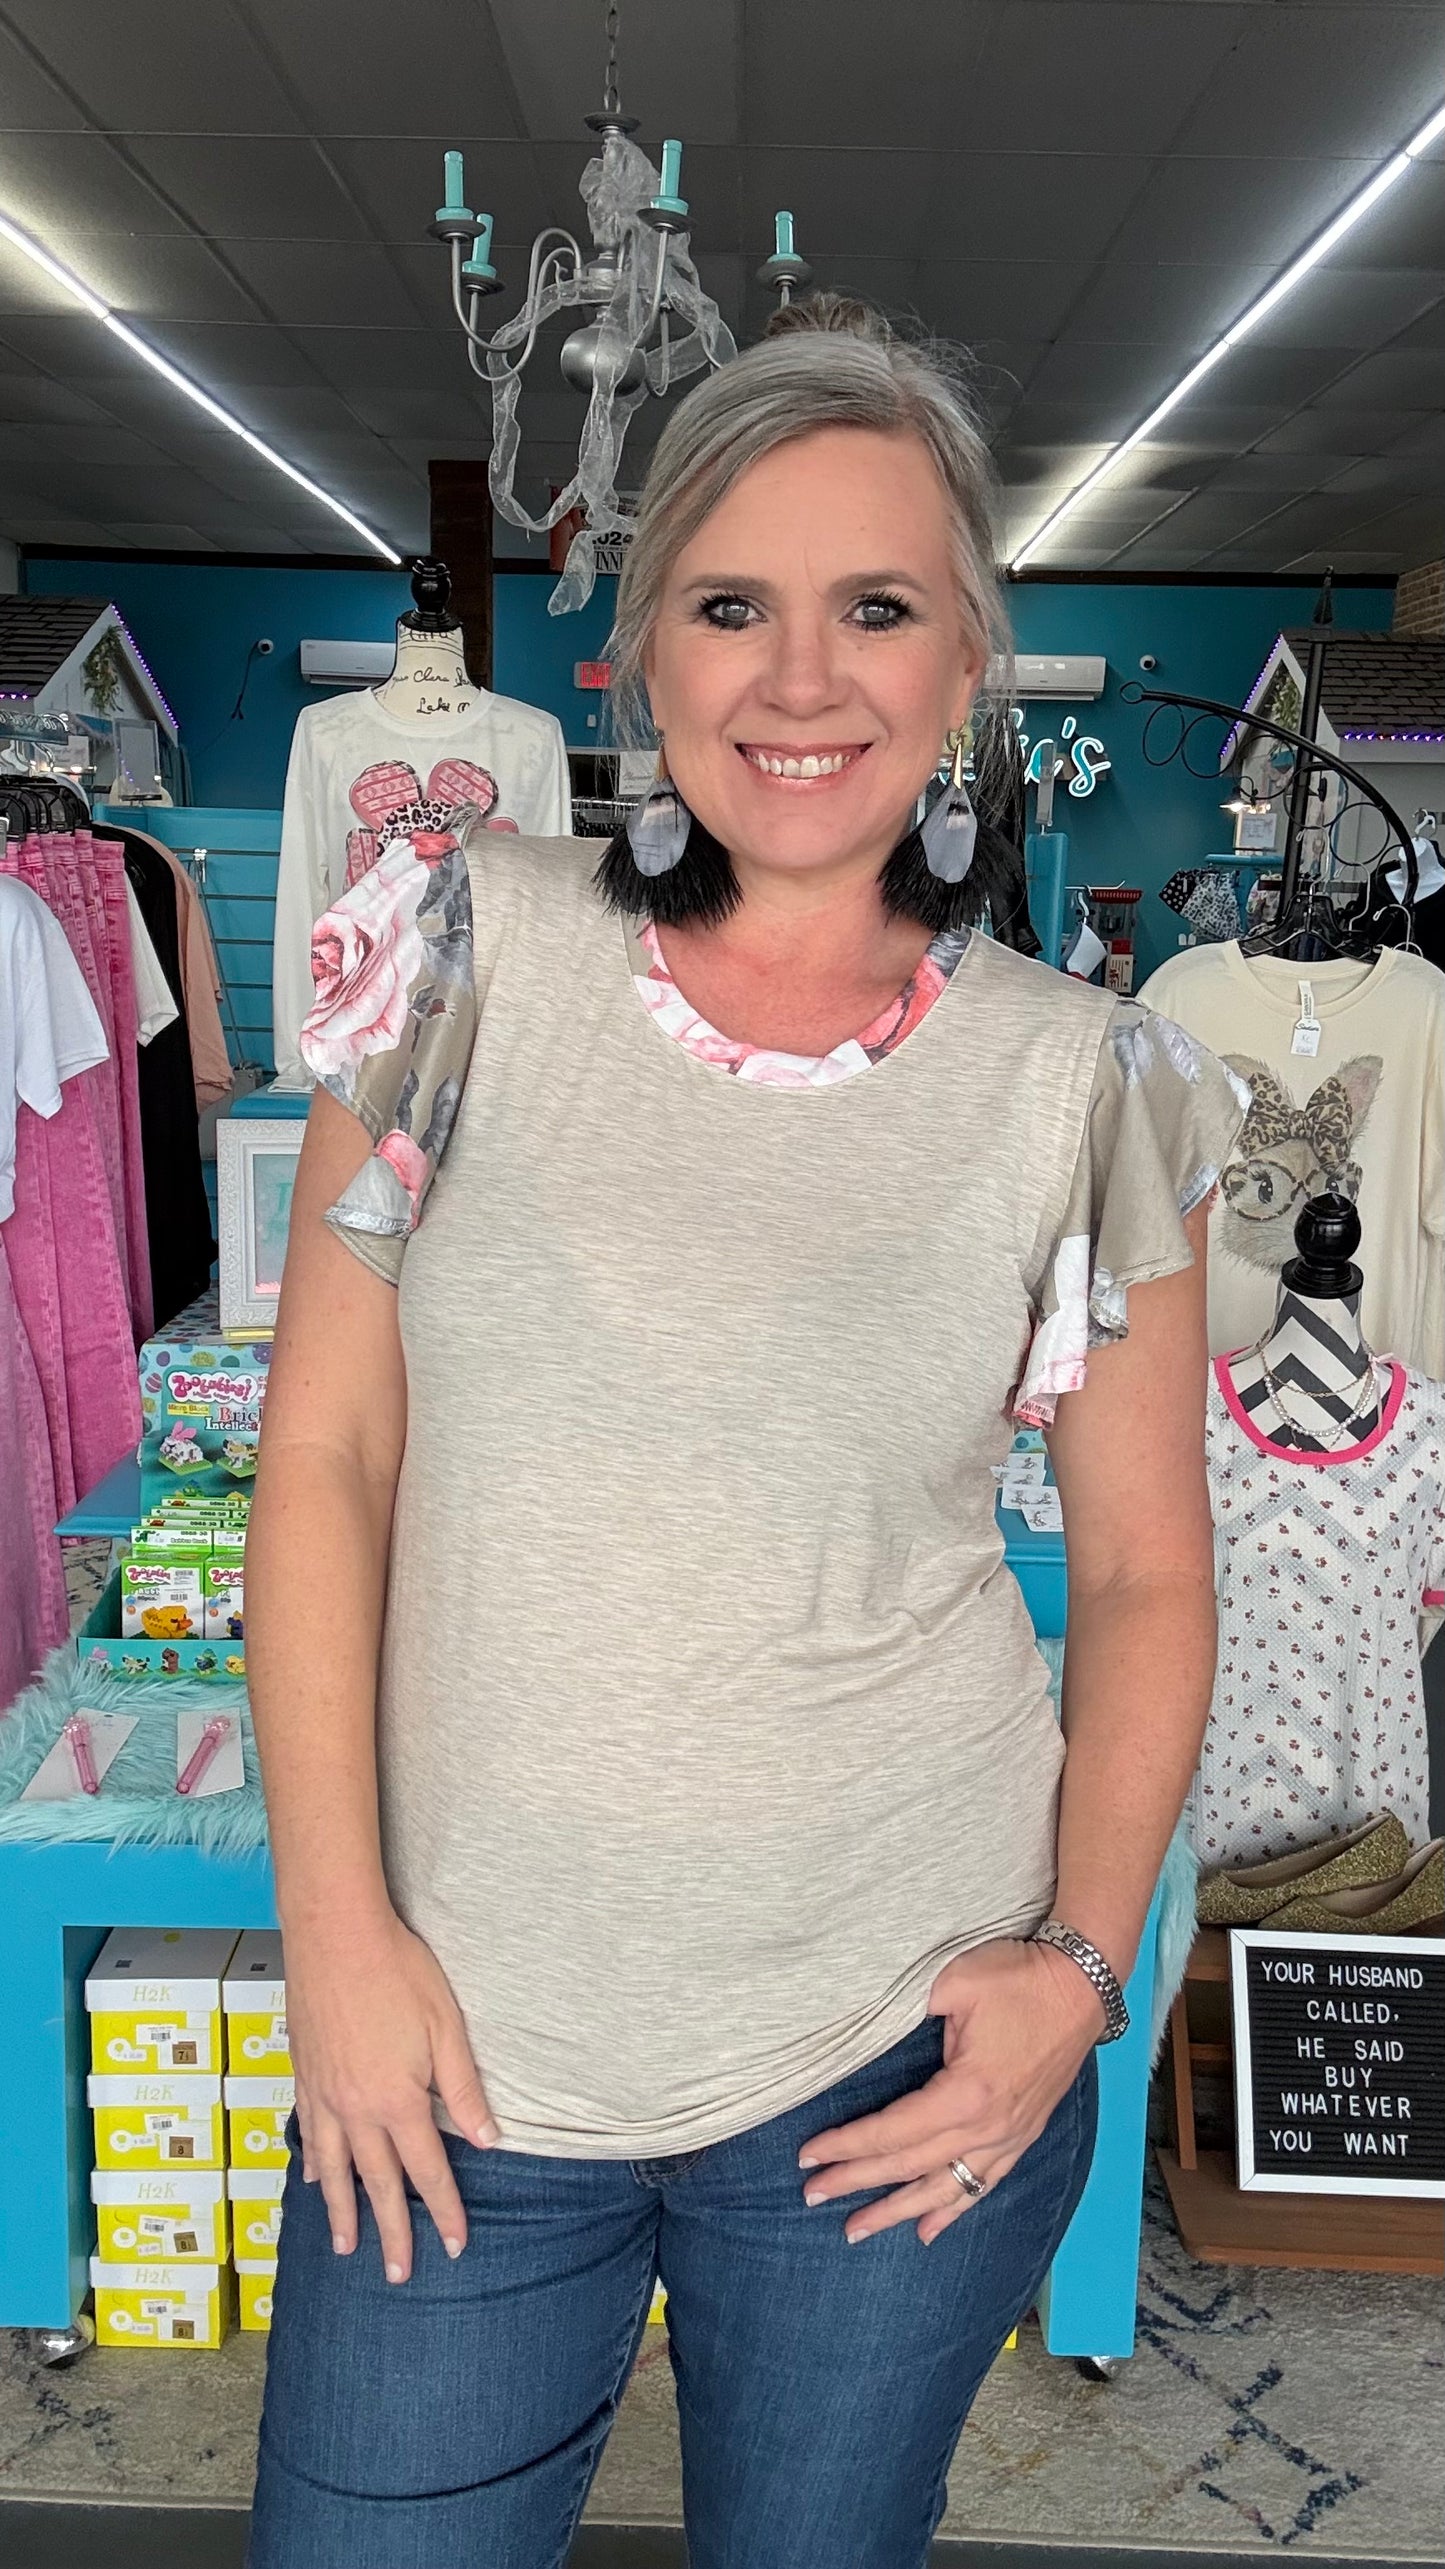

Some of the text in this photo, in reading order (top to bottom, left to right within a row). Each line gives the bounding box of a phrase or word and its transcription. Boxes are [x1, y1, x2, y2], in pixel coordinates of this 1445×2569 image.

[1262, 1961, 1423, 1988] YOUR HUSBAND
[132, 1984, 172, 2002] H2K
[1307, 2001, 1398, 2023] CALLED,
[1297, 2037, 1403, 2061] HE SAID
[1325, 2066, 1372, 2088] BUY
[134, 2083, 175, 2101] H2K
[271, 2087, 295, 2102] H2
[1281, 2093, 1410, 2118] WHATEVER
[1270, 2130, 1408, 2156] YOU WANT
[137, 2181, 178, 2199] H2K
[134, 2267, 175, 2285] H2K
